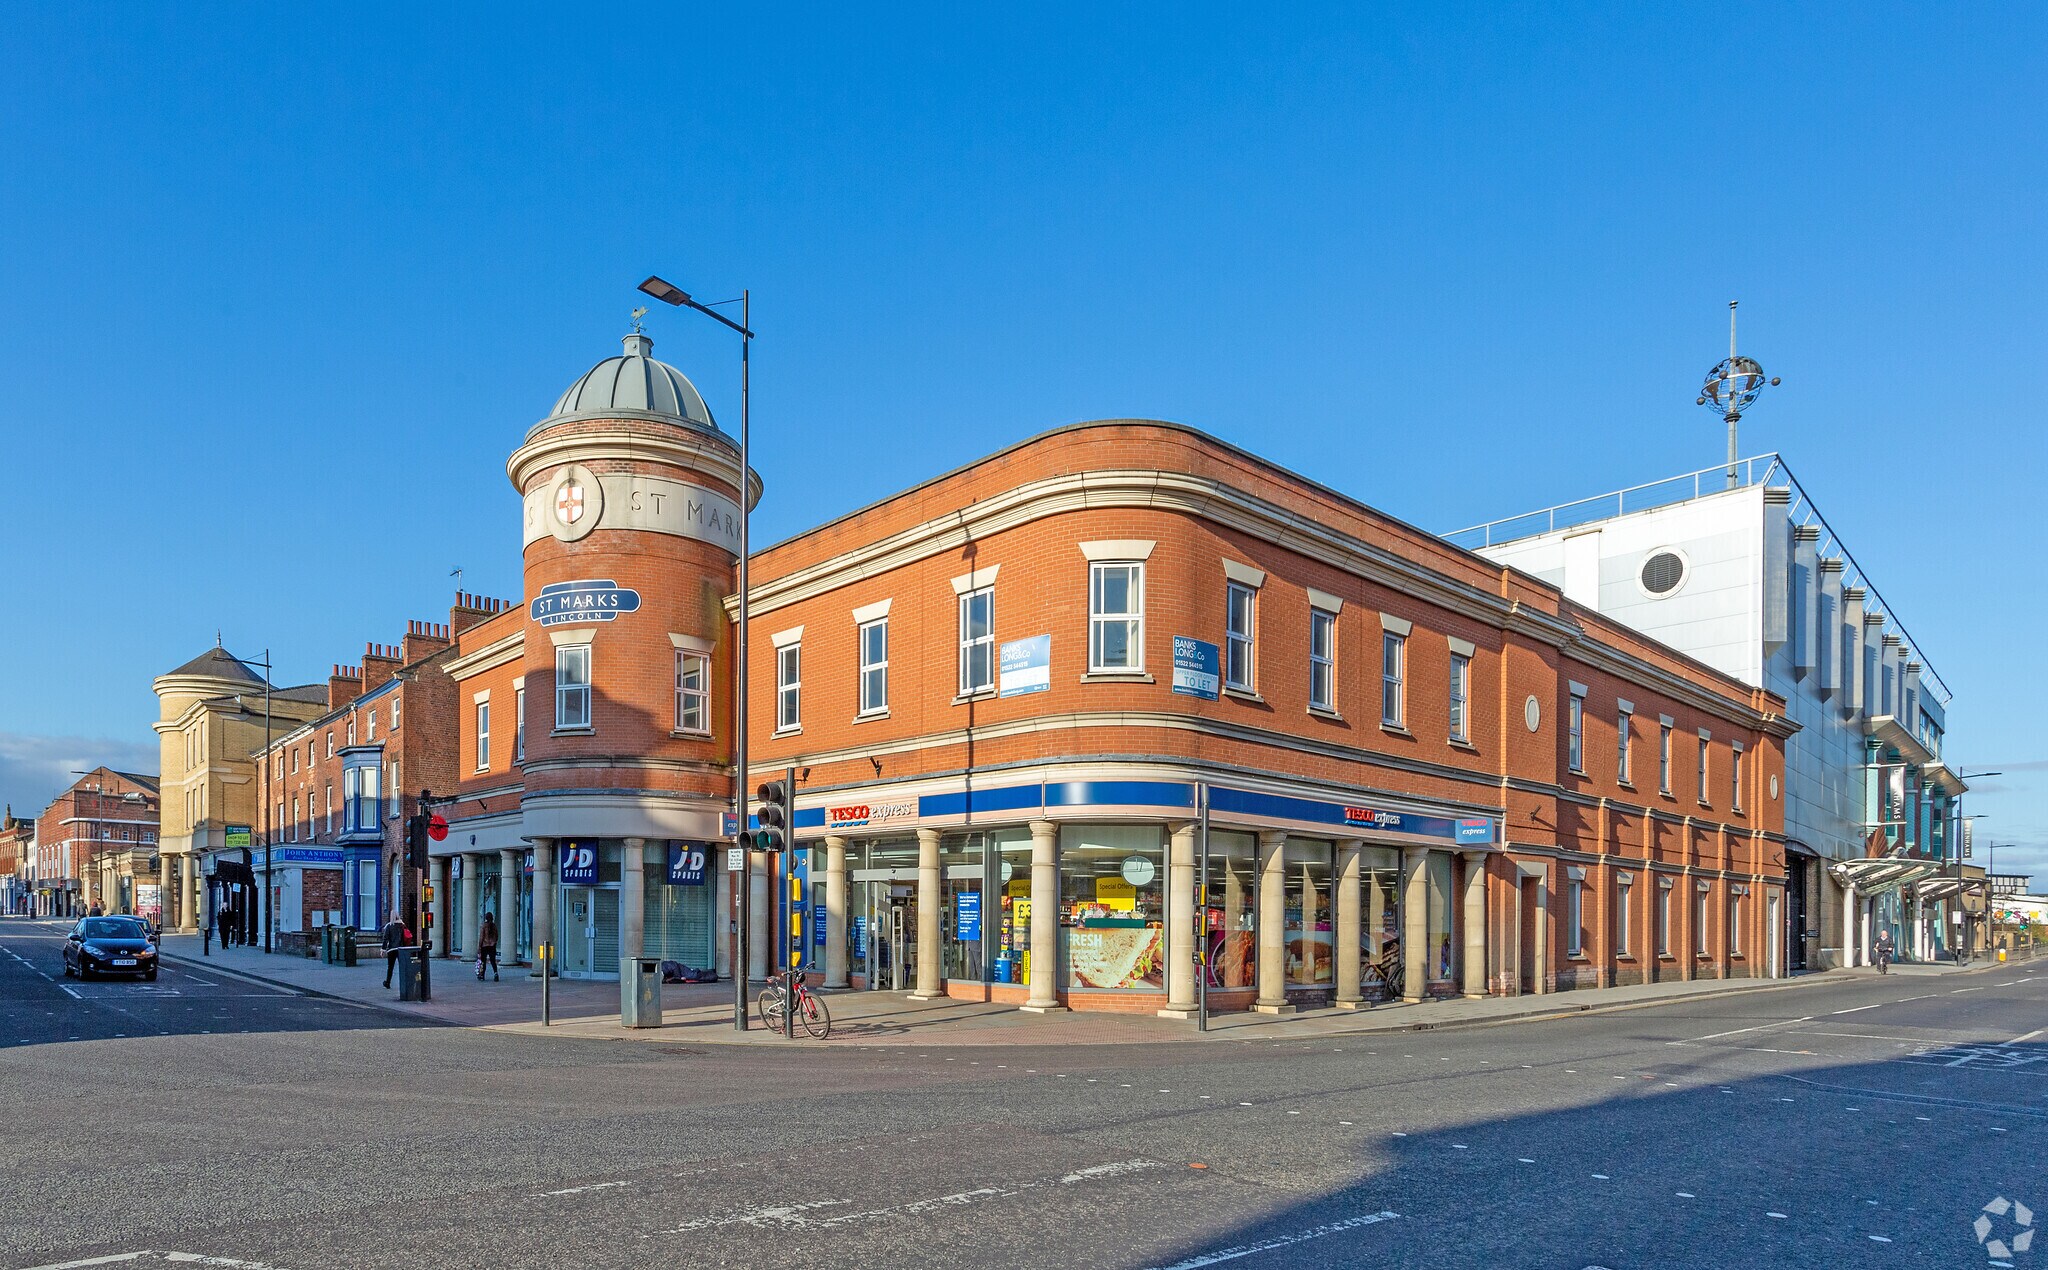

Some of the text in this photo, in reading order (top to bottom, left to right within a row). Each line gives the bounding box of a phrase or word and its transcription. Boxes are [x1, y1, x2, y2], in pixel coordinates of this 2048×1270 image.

[631, 490, 667, 515] ST
[539, 593, 618, 614] ST MARKS
[549, 611, 602, 623] LINCOLN
[1174, 639, 1197, 651] BANKS
[1184, 675, 1211, 690] TO LET
[830, 804, 912, 821] TESCO express
[1344, 807, 1401, 826] TESCO express
[1462, 827, 1486, 835] express
[308, 850, 343, 858] ANTHONY
[565, 869, 592, 877] SPORTS
[673, 871, 701, 879] SPORTS
[1011, 884, 1025, 892] Special
[1099, 883, 1116, 891] Special
[1066, 933, 1102, 947] FRESH
